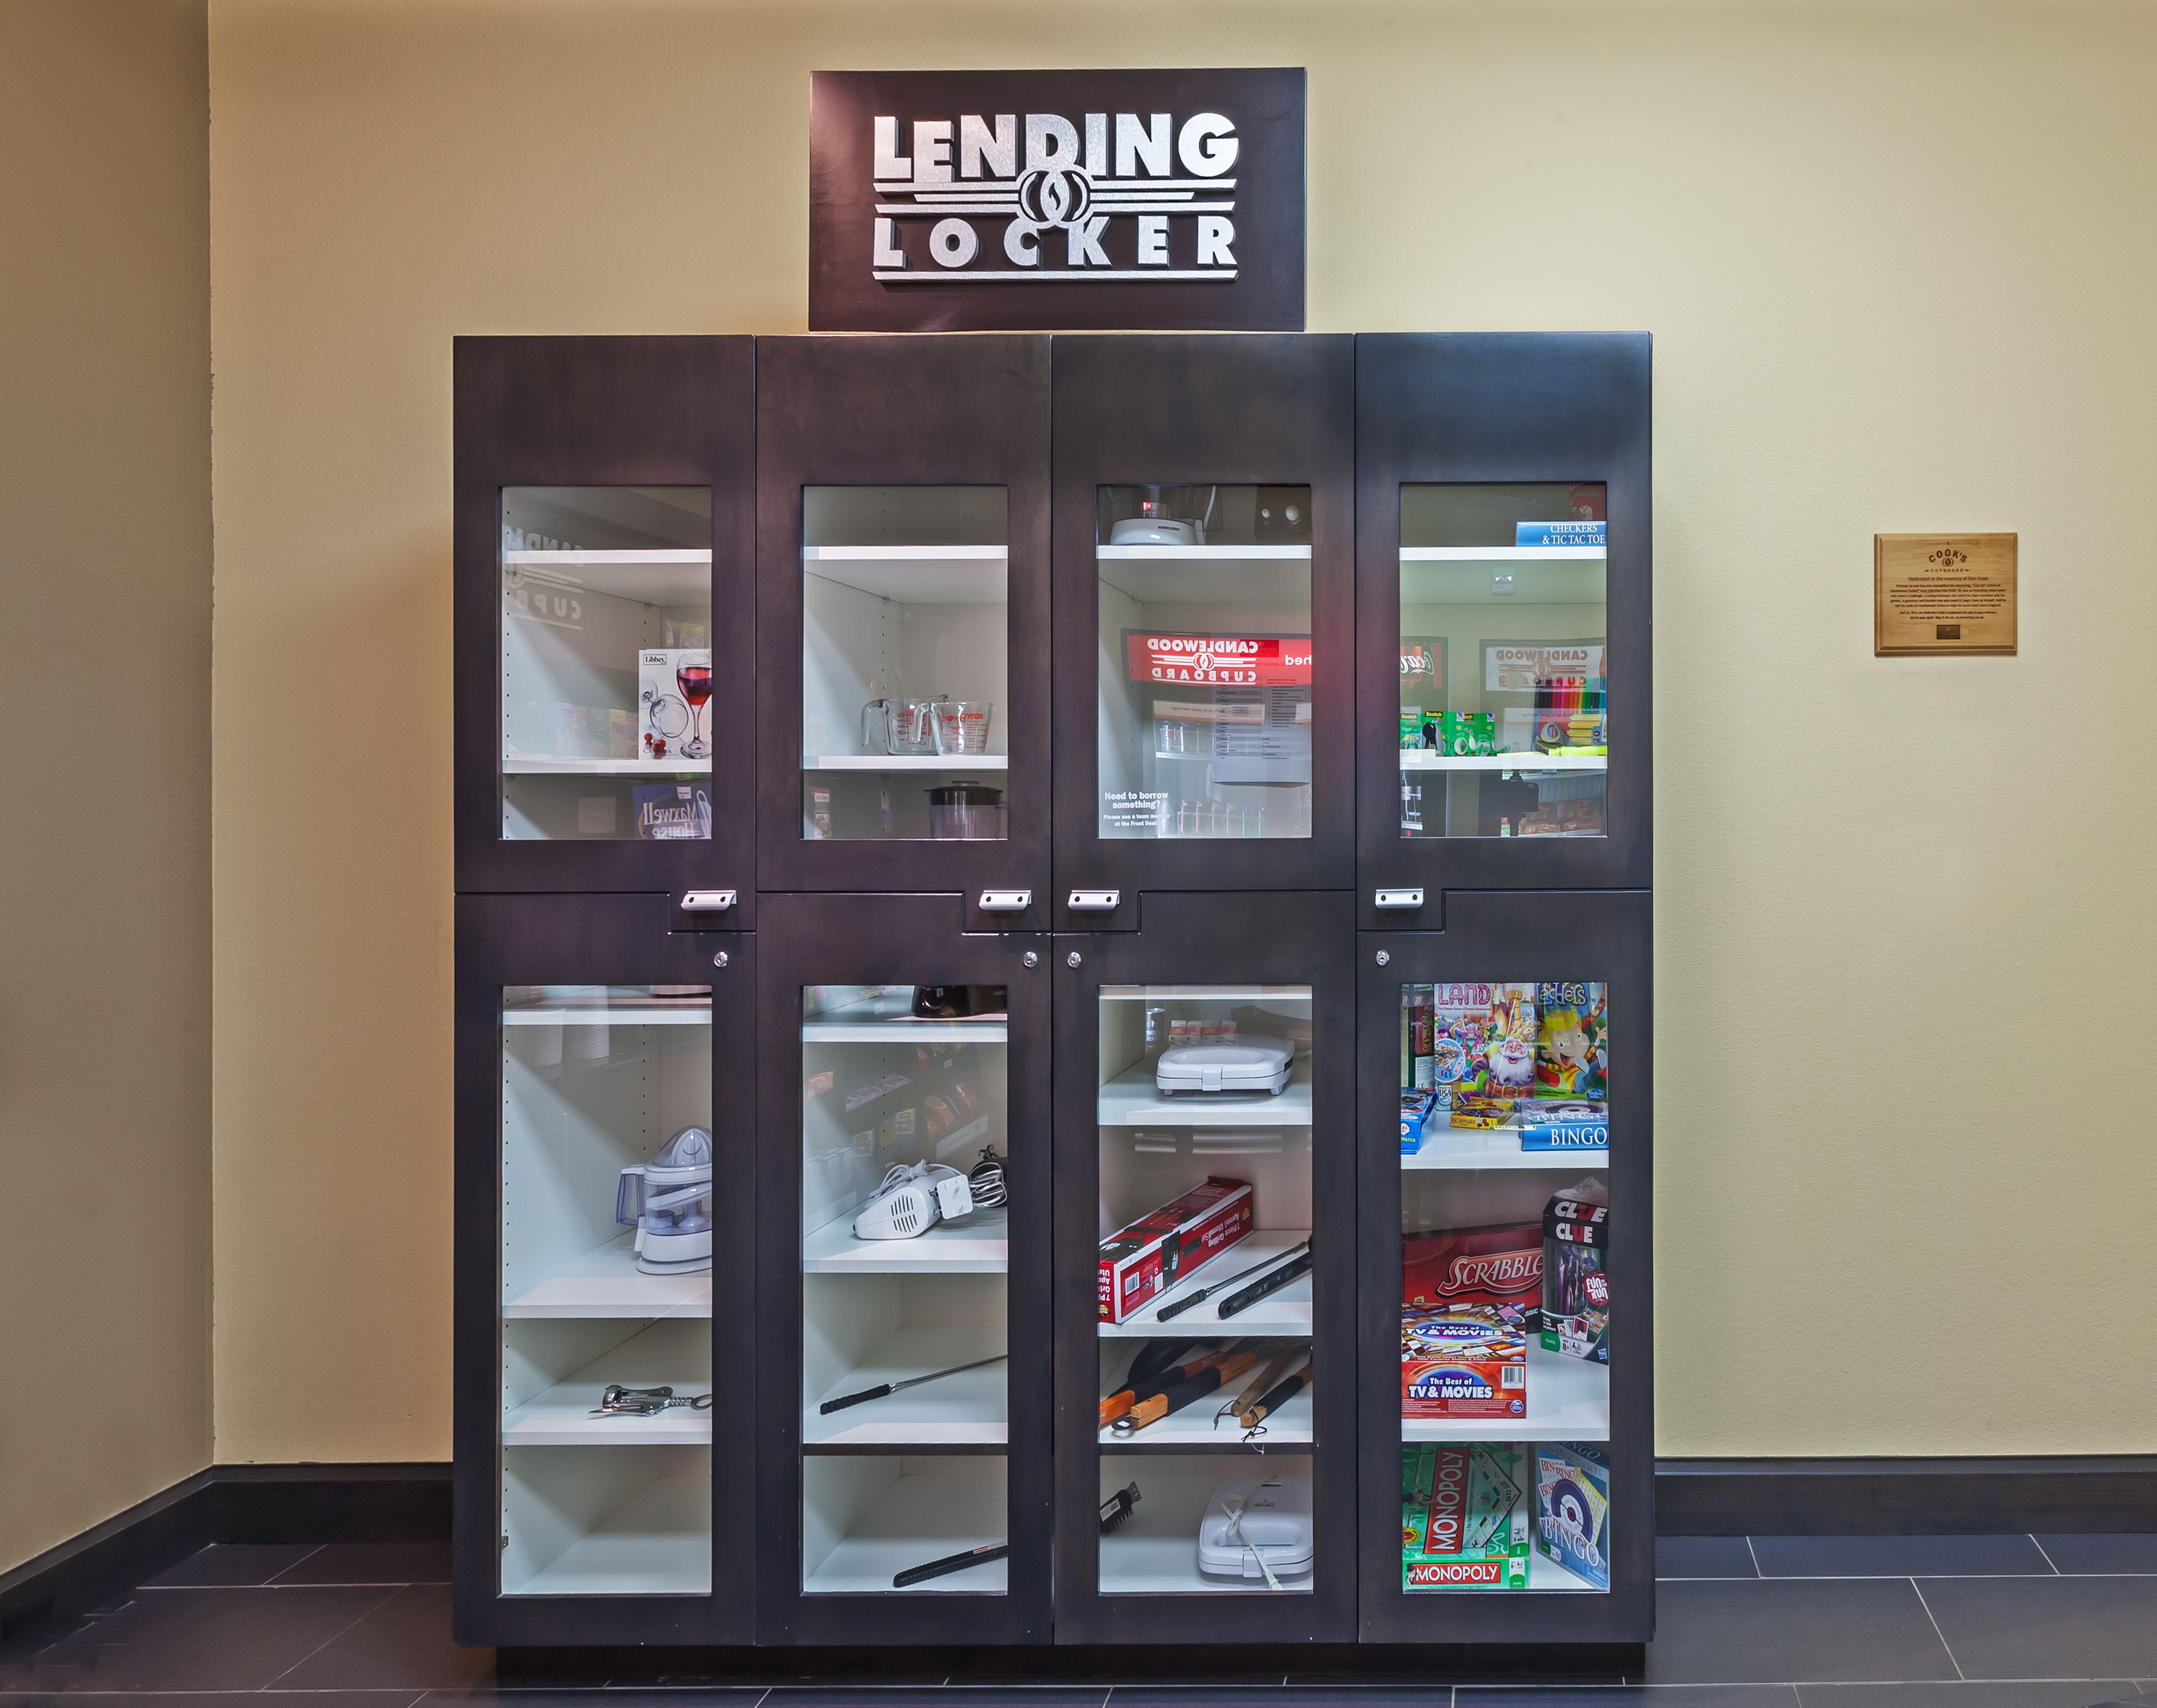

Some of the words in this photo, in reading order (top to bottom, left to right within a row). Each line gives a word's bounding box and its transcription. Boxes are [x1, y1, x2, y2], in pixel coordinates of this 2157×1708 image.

[874, 113, 1239, 183] LENDING
[874, 216, 1237, 269] LOCKER
[1550, 523, 1598, 534] CHECKERS
[1542, 535, 1550, 544] &
[1551, 535, 1567, 544] TIC
[1568, 535, 1585, 544] TAC
[1587, 535, 1605, 544] TOE
[1929, 549, 1967, 563] COOK'S
[1112, 800, 1161, 809] something?
[1437, 983, 1491, 1005] LAND
[1439, 1090, 1451, 1098] USA
[1550, 1127, 1607, 1146] BINGO
[1554, 1201, 1608, 1222] CLUE
[1556, 1223, 1592, 1244] CLUE
[1444, 1255, 1543, 1290] SCRABBLE
[1409, 1386, 1427, 1398] TV
[1427, 1386, 1439, 1399] &
[1441, 1386, 1492, 1399] MOVIES
[1430, 1451, 1464, 1550] MONOPOLY
[1544, 1515, 1600, 1567] BINGO
[1416, 1565, 1498, 1582] MONOPOLY
